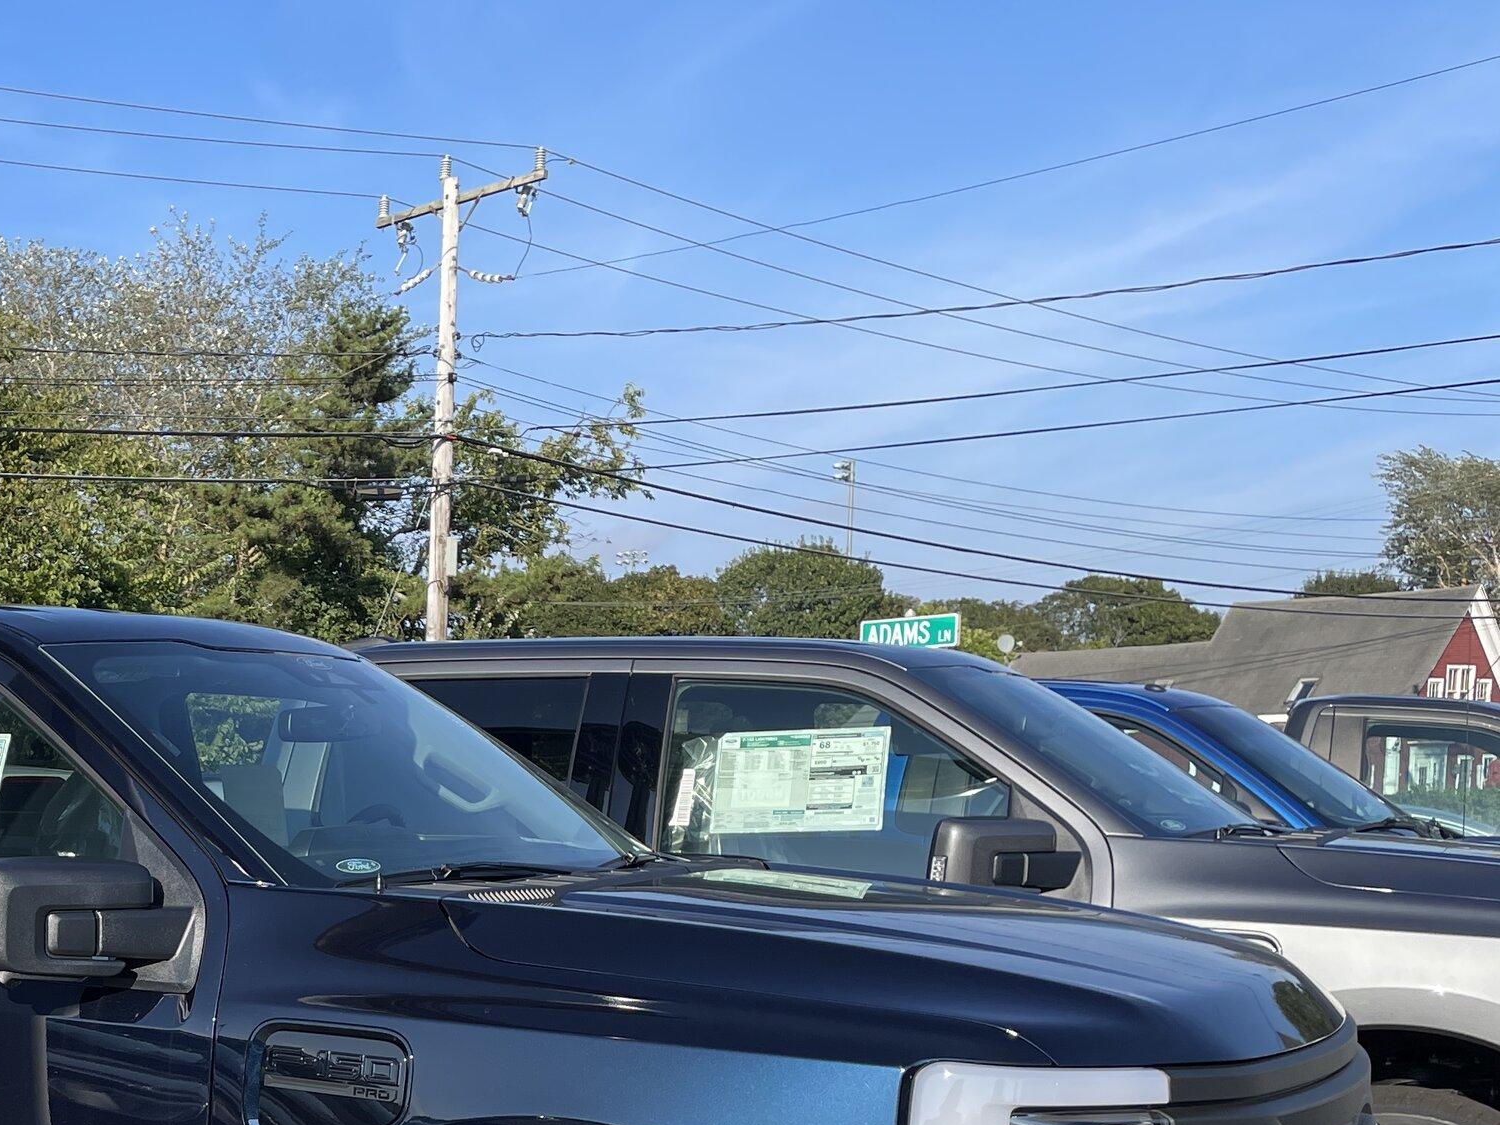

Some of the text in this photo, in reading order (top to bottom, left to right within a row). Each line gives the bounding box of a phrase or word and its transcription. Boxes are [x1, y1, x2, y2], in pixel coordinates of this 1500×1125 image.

[867, 620, 952, 646] ADAMS LN
[819, 741, 831, 749] 68
[353, 1086, 390, 1100] PRO
